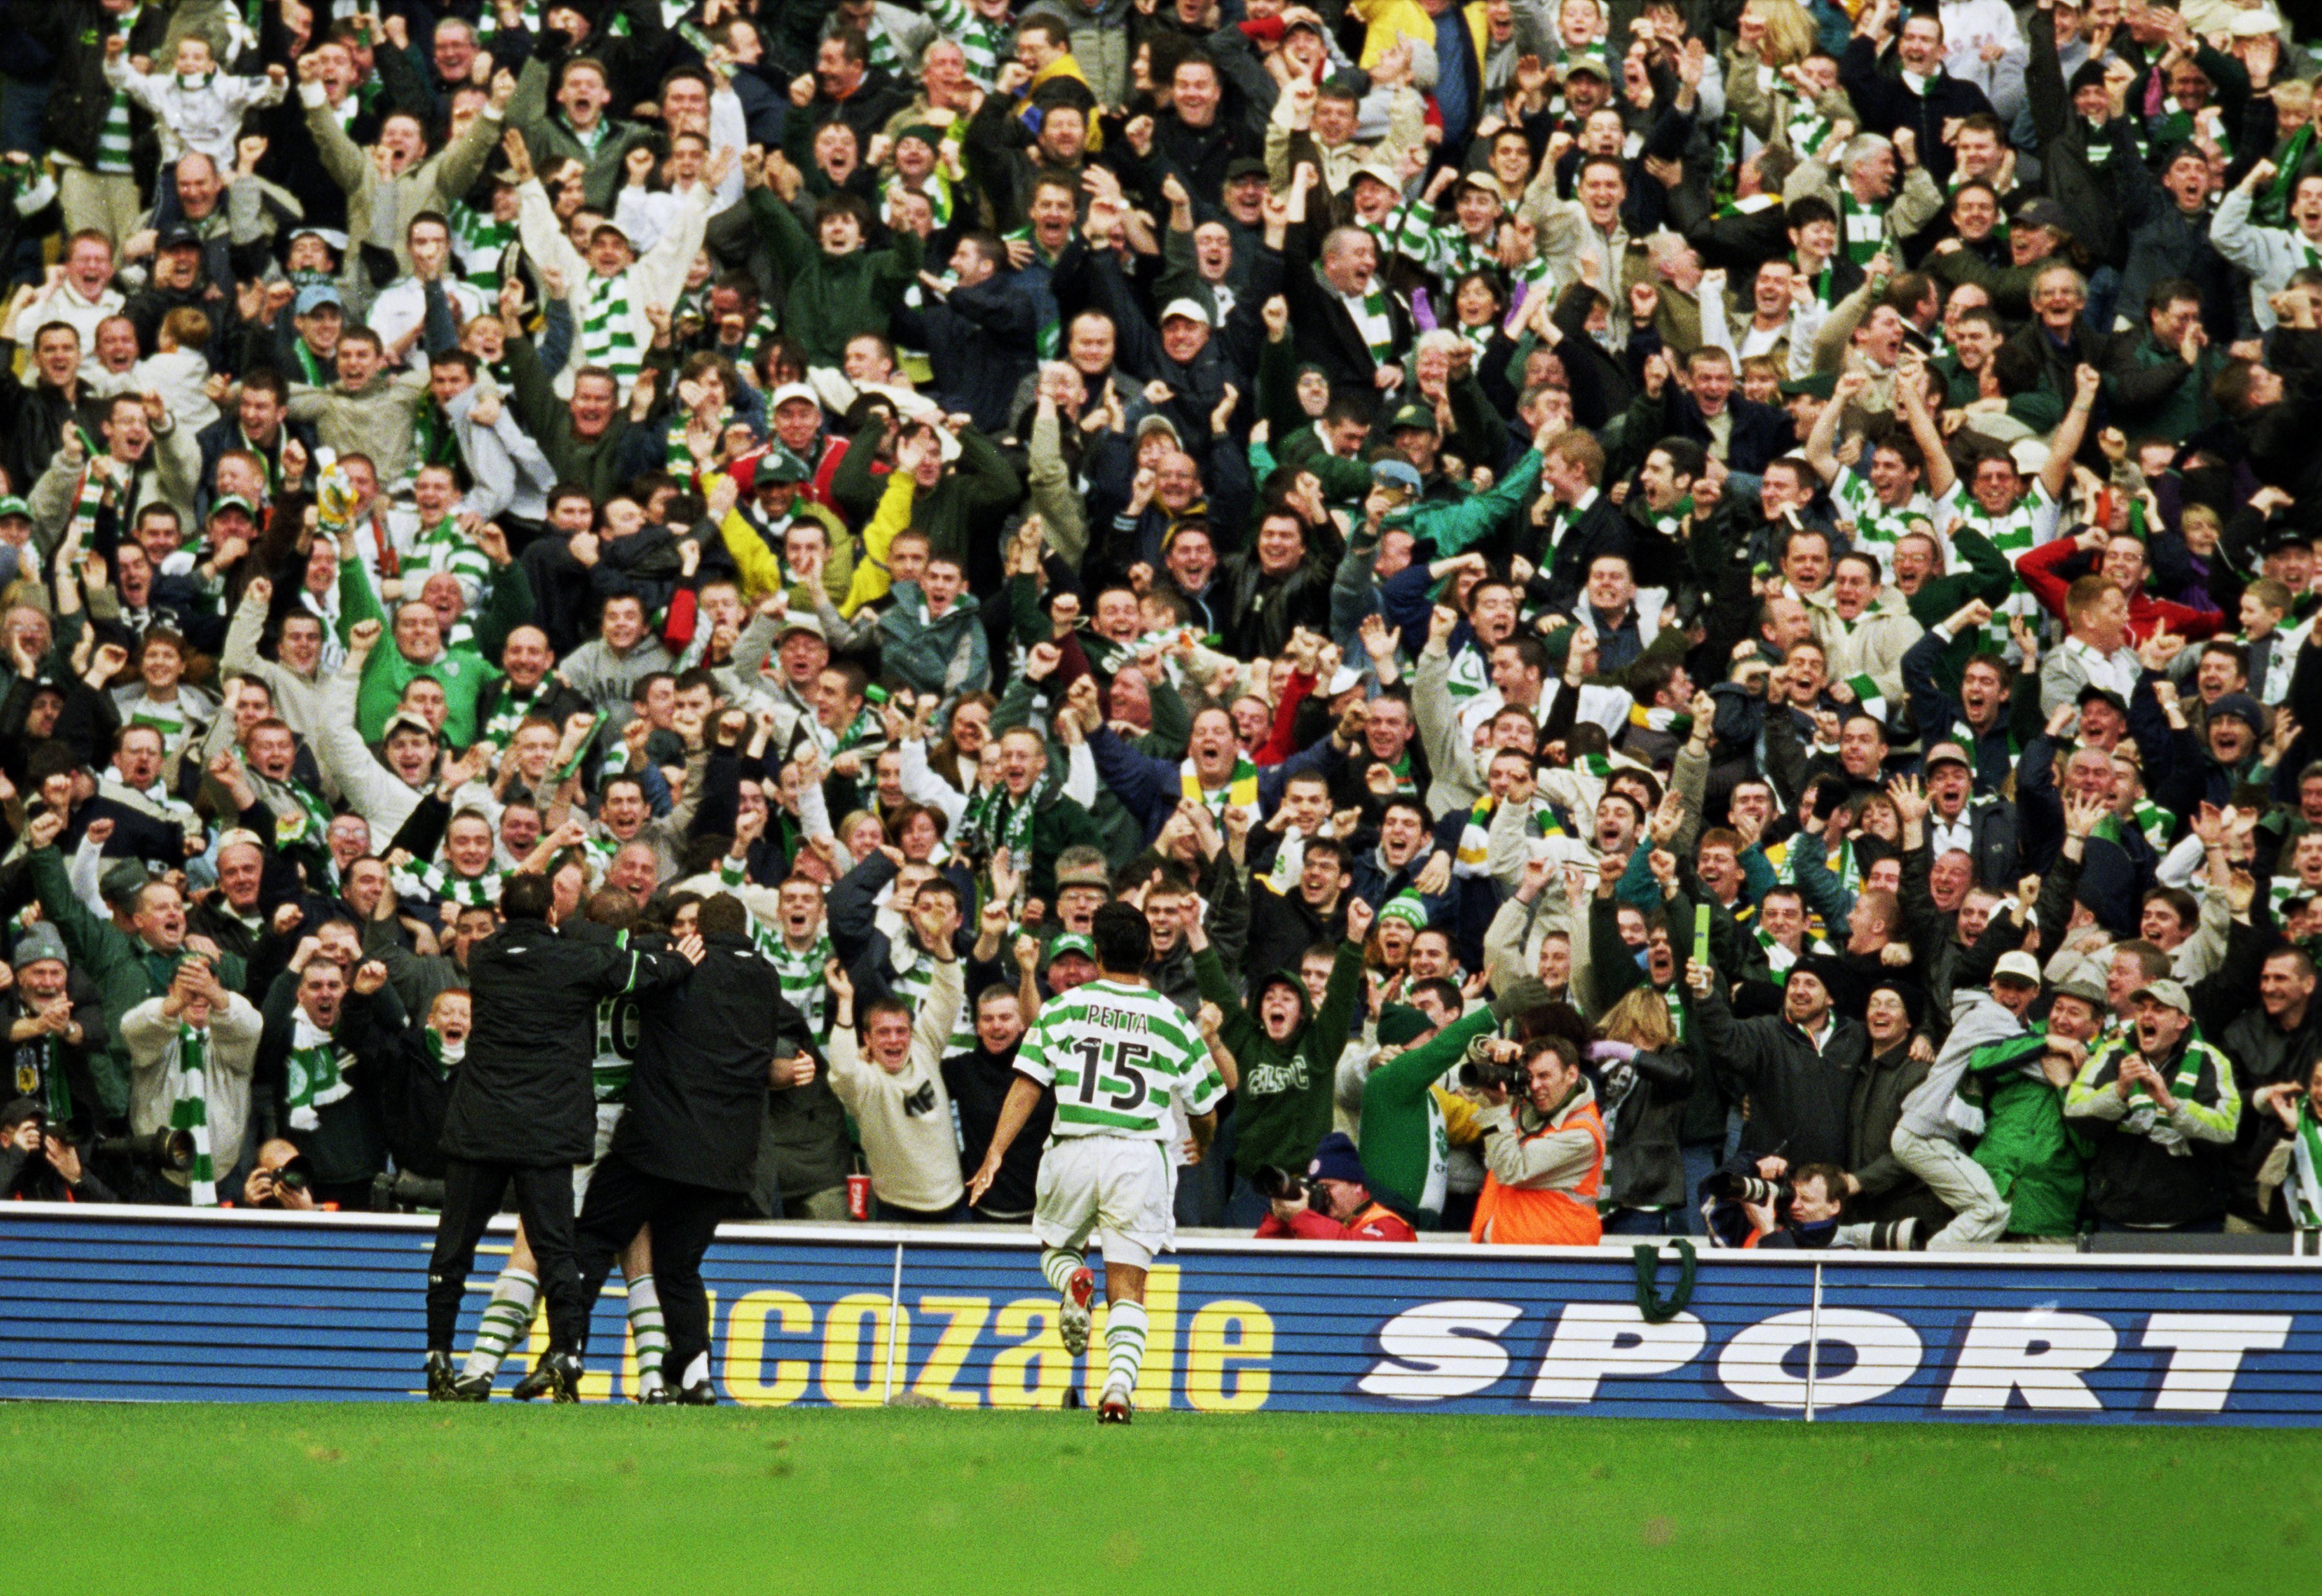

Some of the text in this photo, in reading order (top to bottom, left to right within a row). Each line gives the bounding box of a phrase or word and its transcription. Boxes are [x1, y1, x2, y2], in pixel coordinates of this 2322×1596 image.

[1087, 1004, 1147, 1034] PETTA
[1073, 1036, 1149, 1110] 15
[526, 1254, 2294, 1414] cozade SPORT
